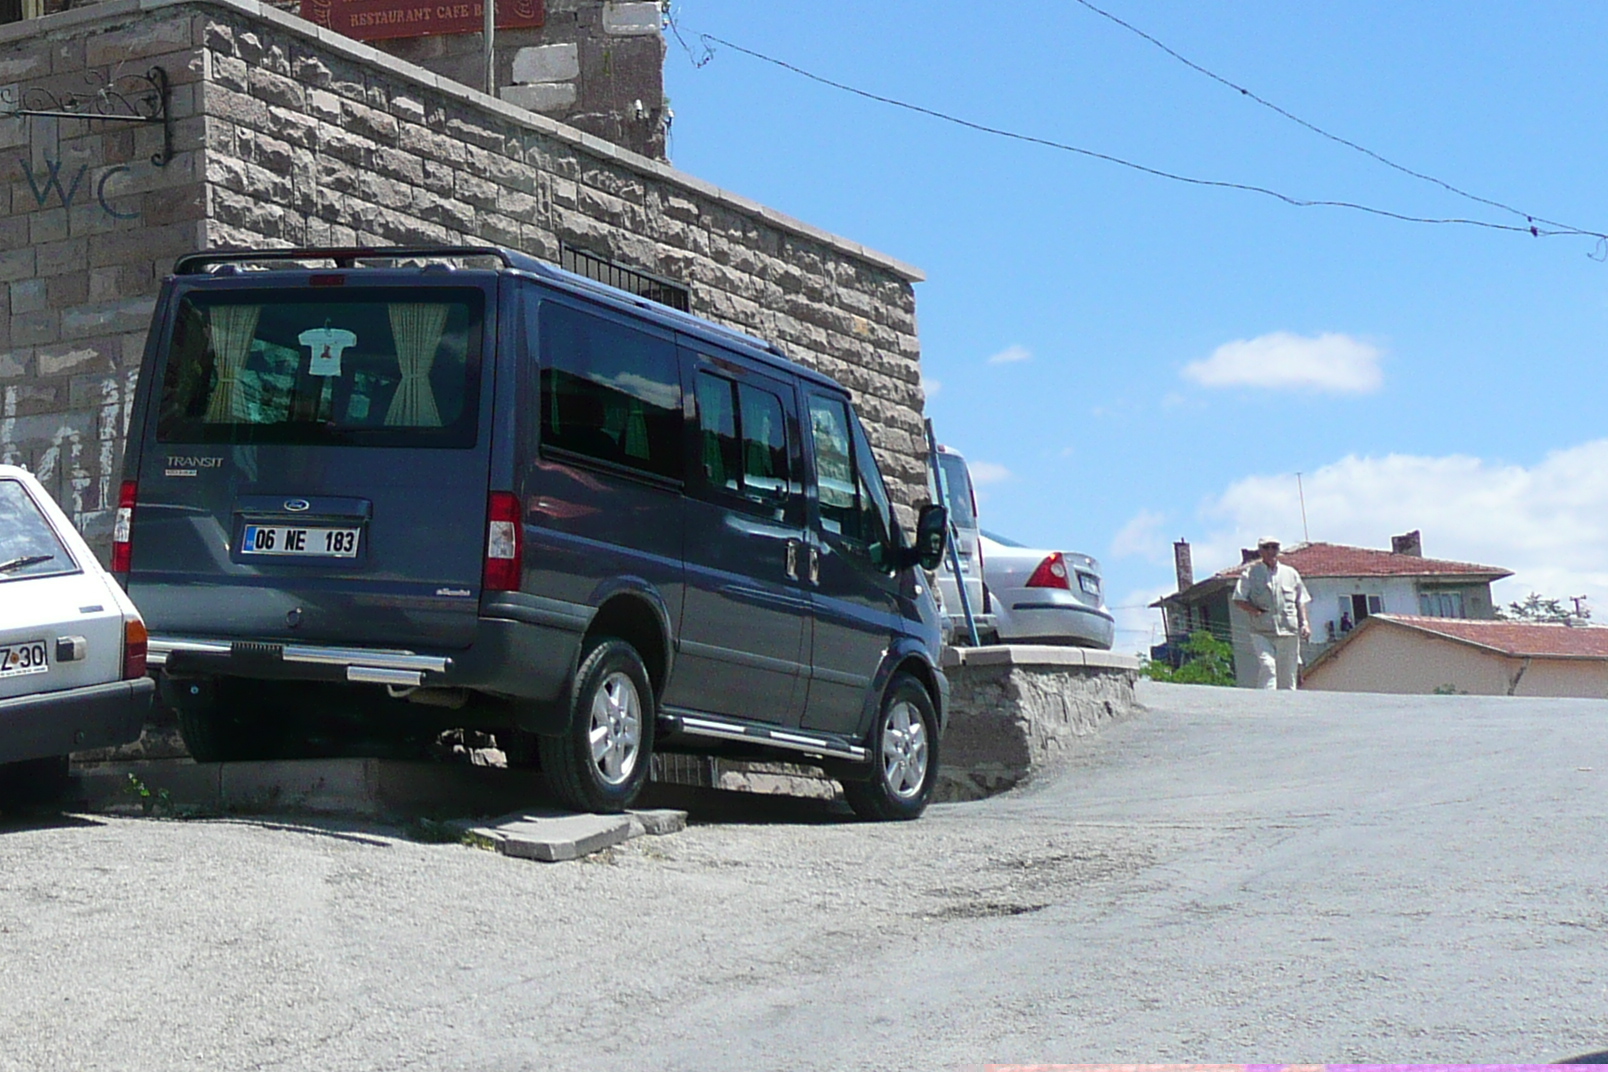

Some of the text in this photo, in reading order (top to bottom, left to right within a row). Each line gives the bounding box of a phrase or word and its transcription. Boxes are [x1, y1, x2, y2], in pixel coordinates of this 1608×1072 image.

[350, 7, 432, 28] RESTAURANT
[436, 4, 469, 19] CAFE
[166, 456, 224, 468] TRANSIT
[255, 529, 355, 552] 06 NE 183
[19, 645, 44, 668] 30
